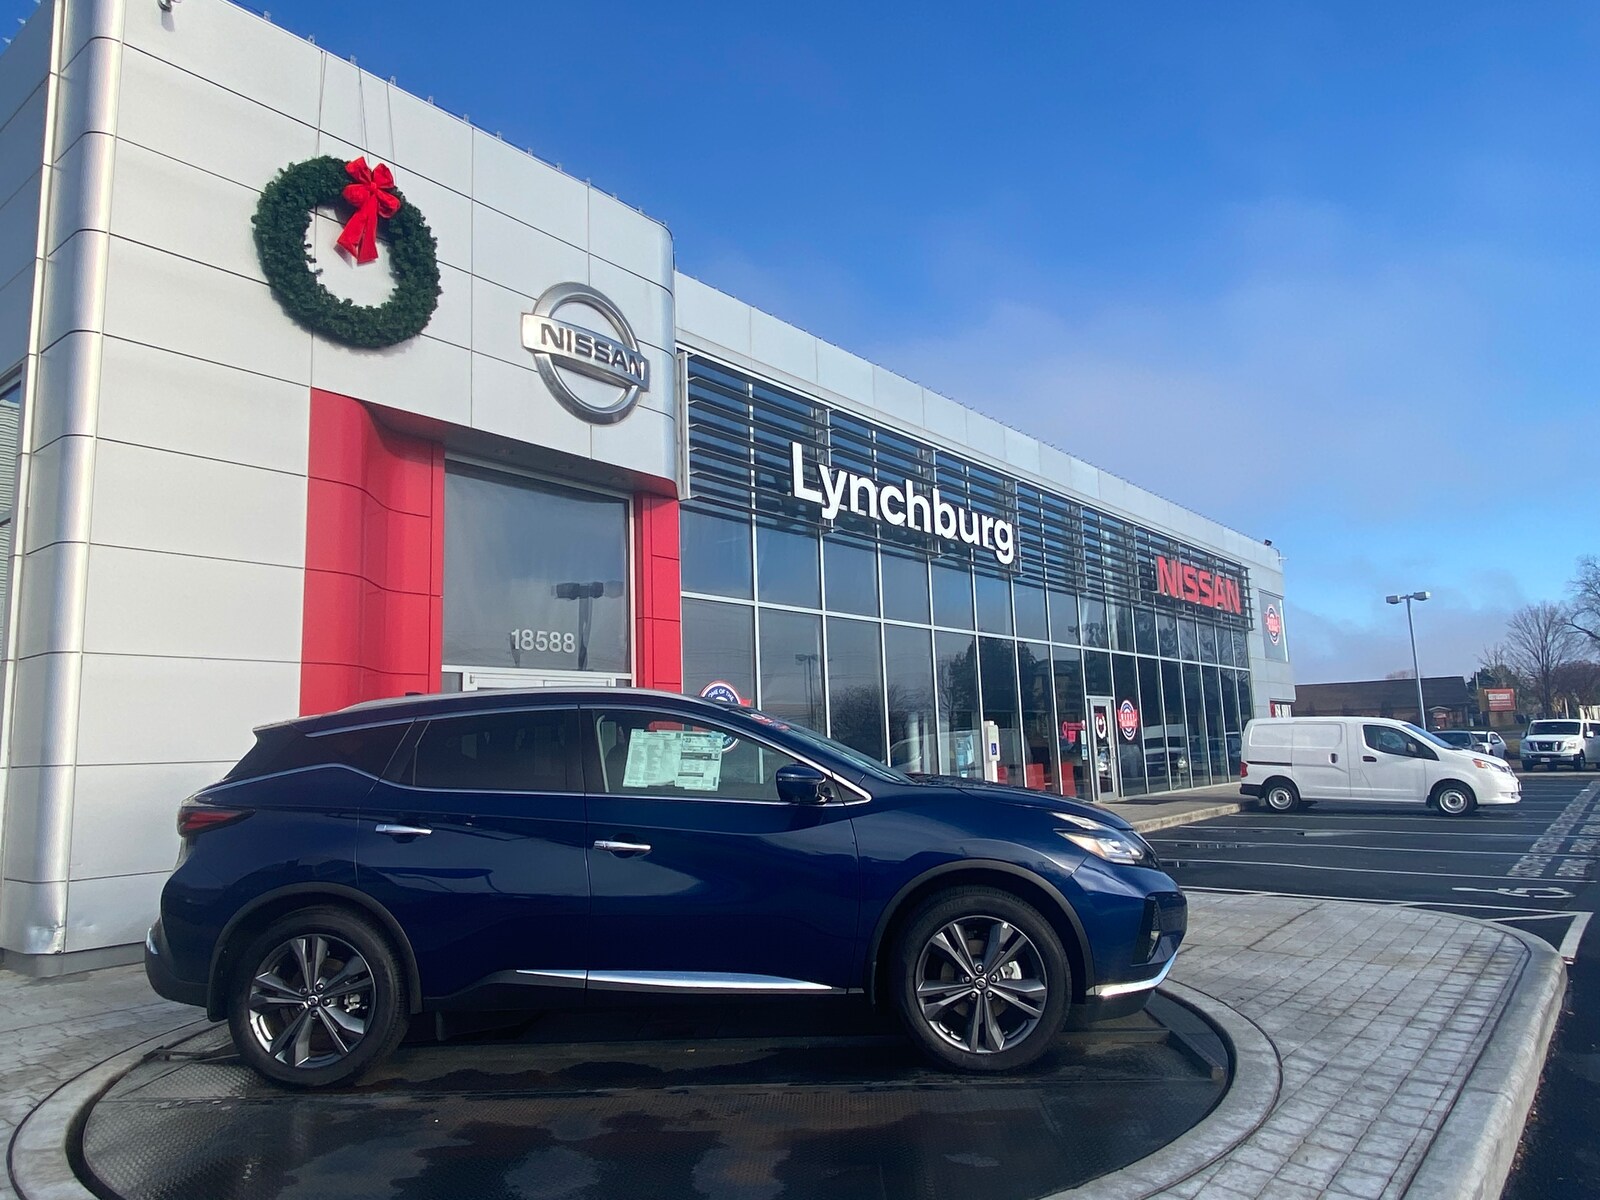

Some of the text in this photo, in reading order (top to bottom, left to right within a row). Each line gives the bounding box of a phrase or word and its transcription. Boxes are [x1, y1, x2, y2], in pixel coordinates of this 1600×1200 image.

[541, 322, 645, 381] NISSAN
[791, 441, 1015, 565] Lynchburg
[1155, 555, 1241, 615] NISSAN
[511, 628, 576, 653] 18588
